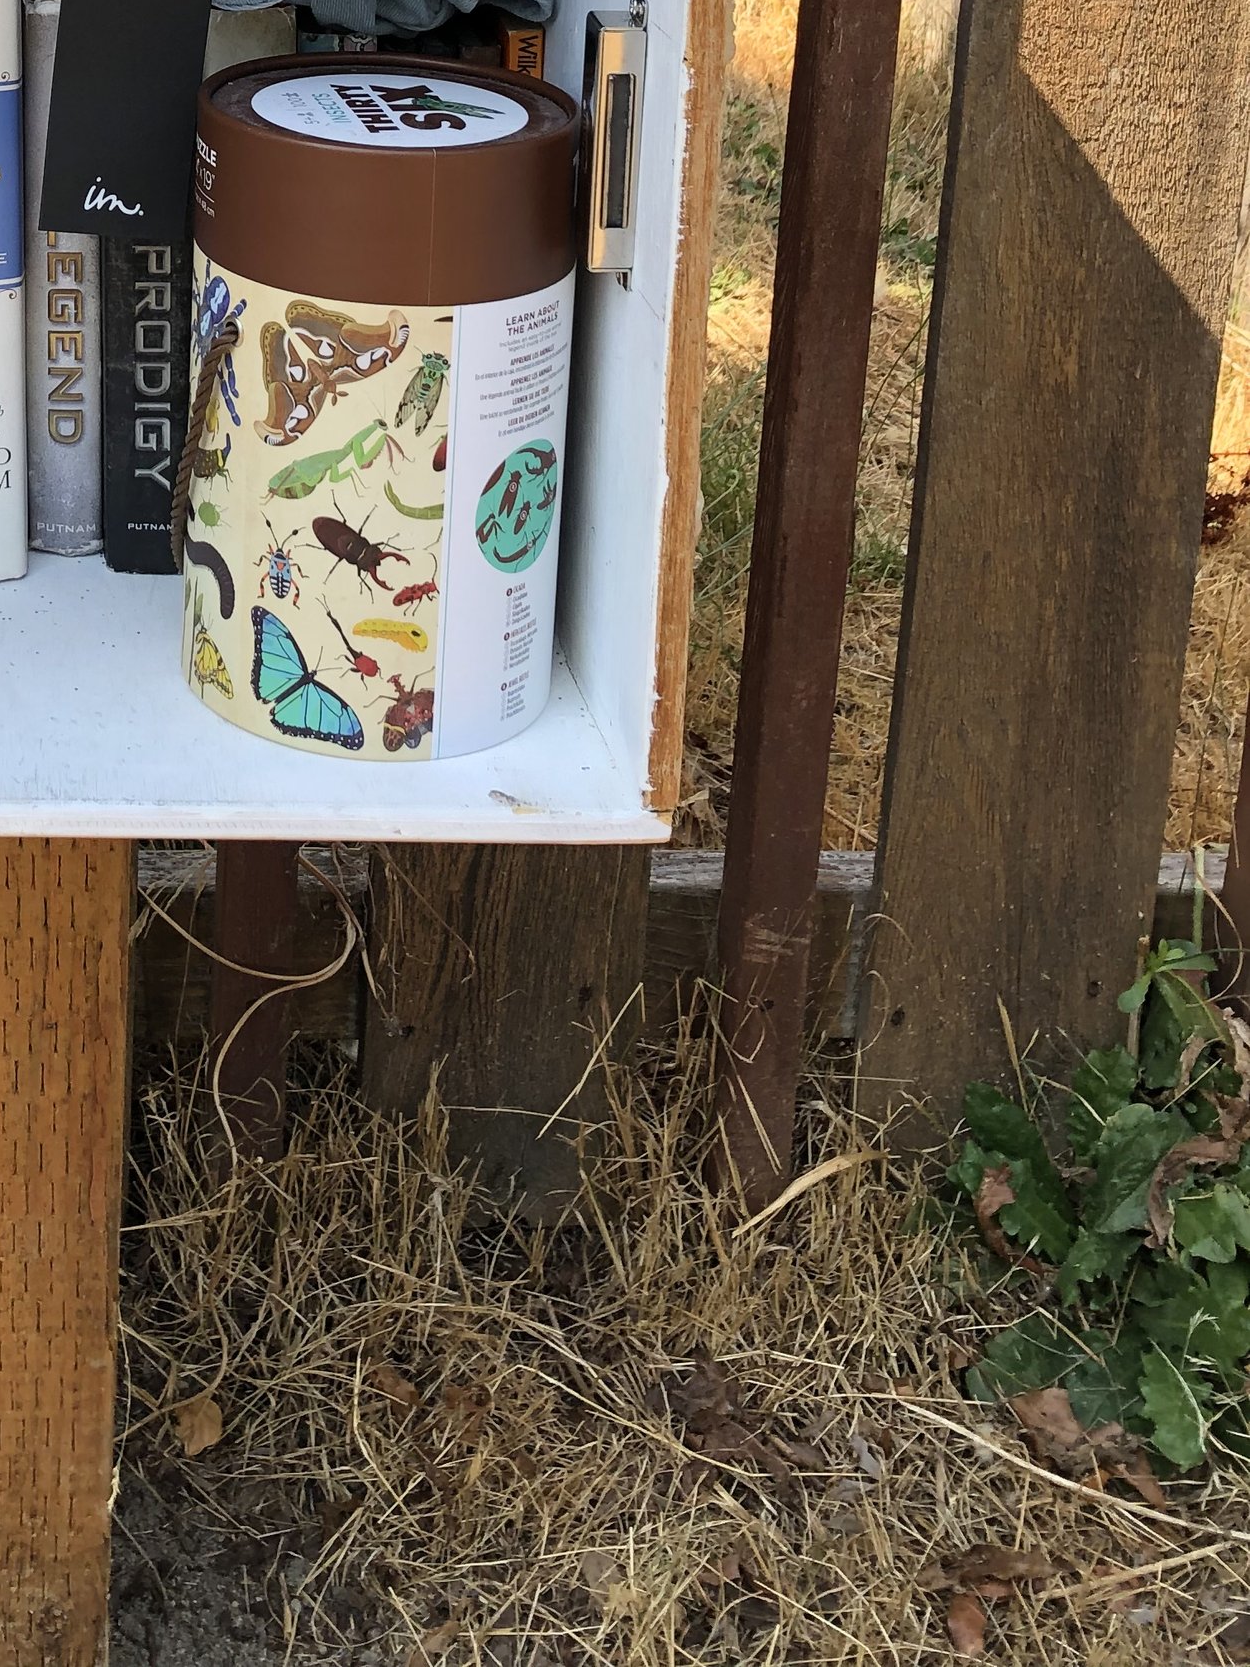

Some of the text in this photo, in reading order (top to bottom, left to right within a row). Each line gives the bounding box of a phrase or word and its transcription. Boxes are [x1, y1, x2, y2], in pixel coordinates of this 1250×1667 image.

[329, 83, 401, 134] THIRTY
[368, 83, 467, 131] SIX
[506, 300, 560, 326] LEARN ABOUT
[507, 325, 524, 336] THE
[527, 312, 558, 331] ANIMALS
[132, 245, 171, 492] PRODIGY
[37, 522, 97, 533] PUTNAM
